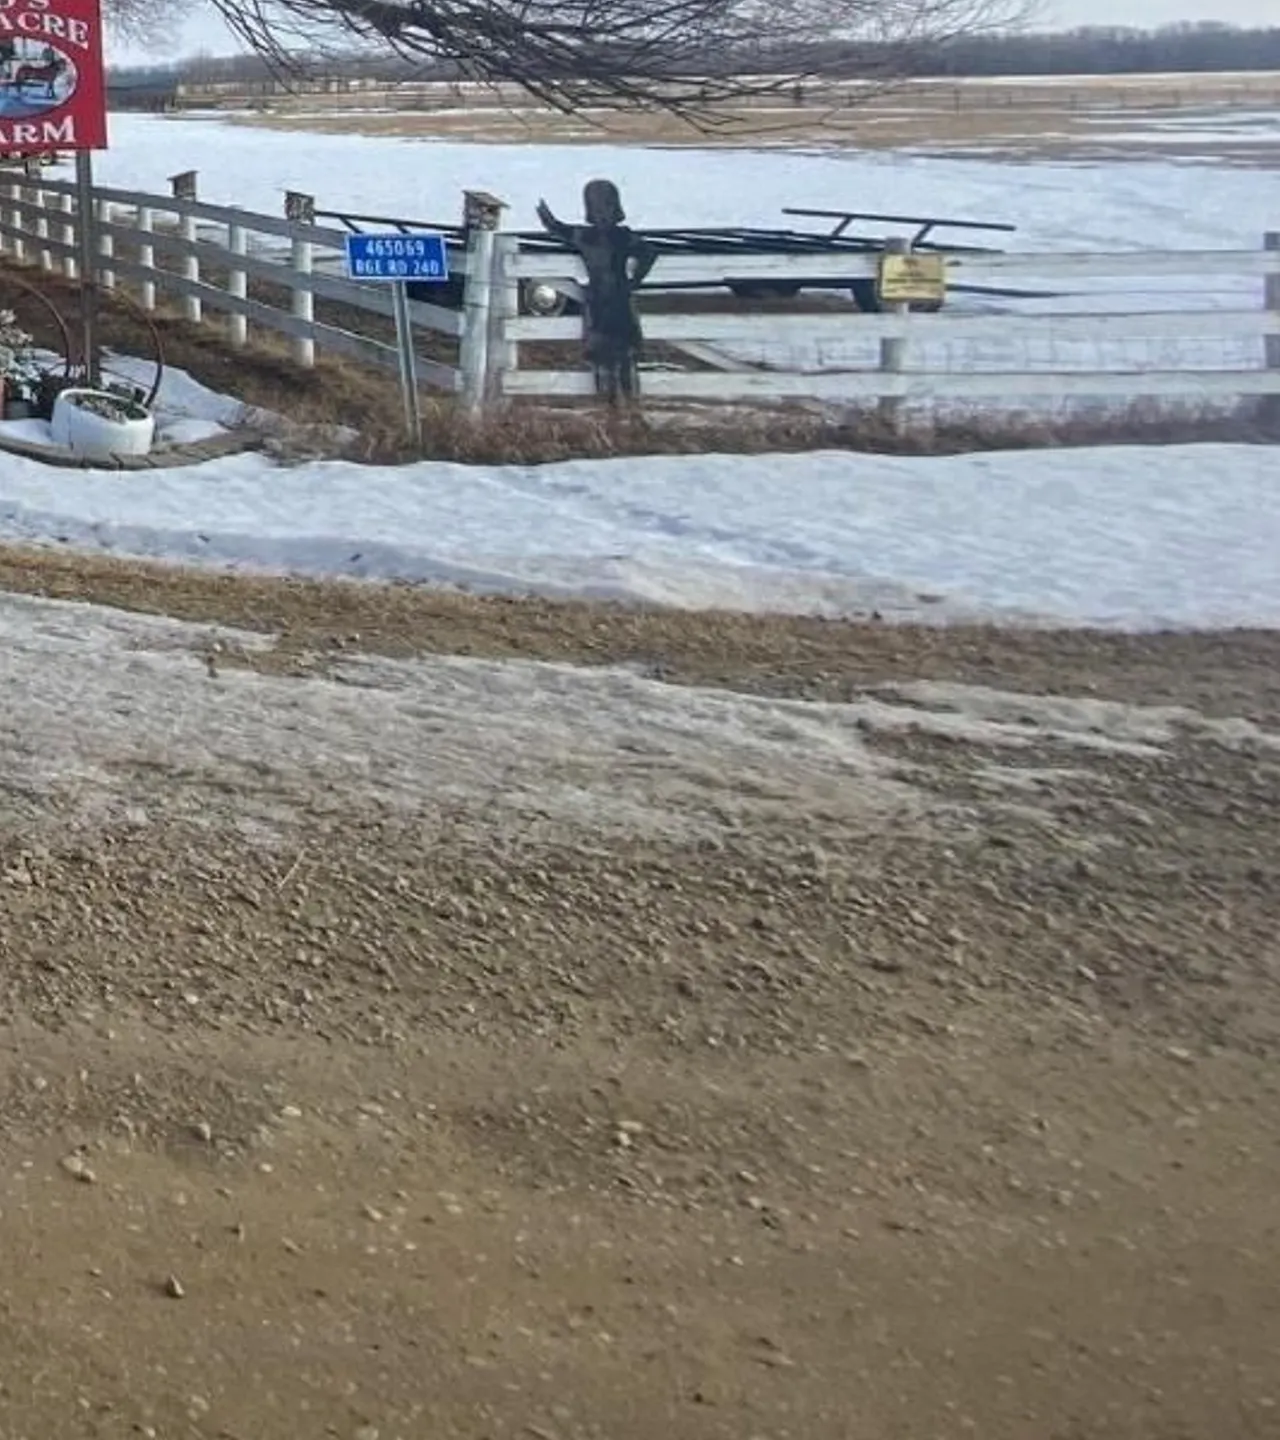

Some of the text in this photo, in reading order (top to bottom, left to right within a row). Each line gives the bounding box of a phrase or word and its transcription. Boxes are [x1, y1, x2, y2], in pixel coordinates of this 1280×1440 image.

[365, 240, 425, 256] 465069
[387, 259, 408, 275] RD
[413, 259, 439, 275] 240
